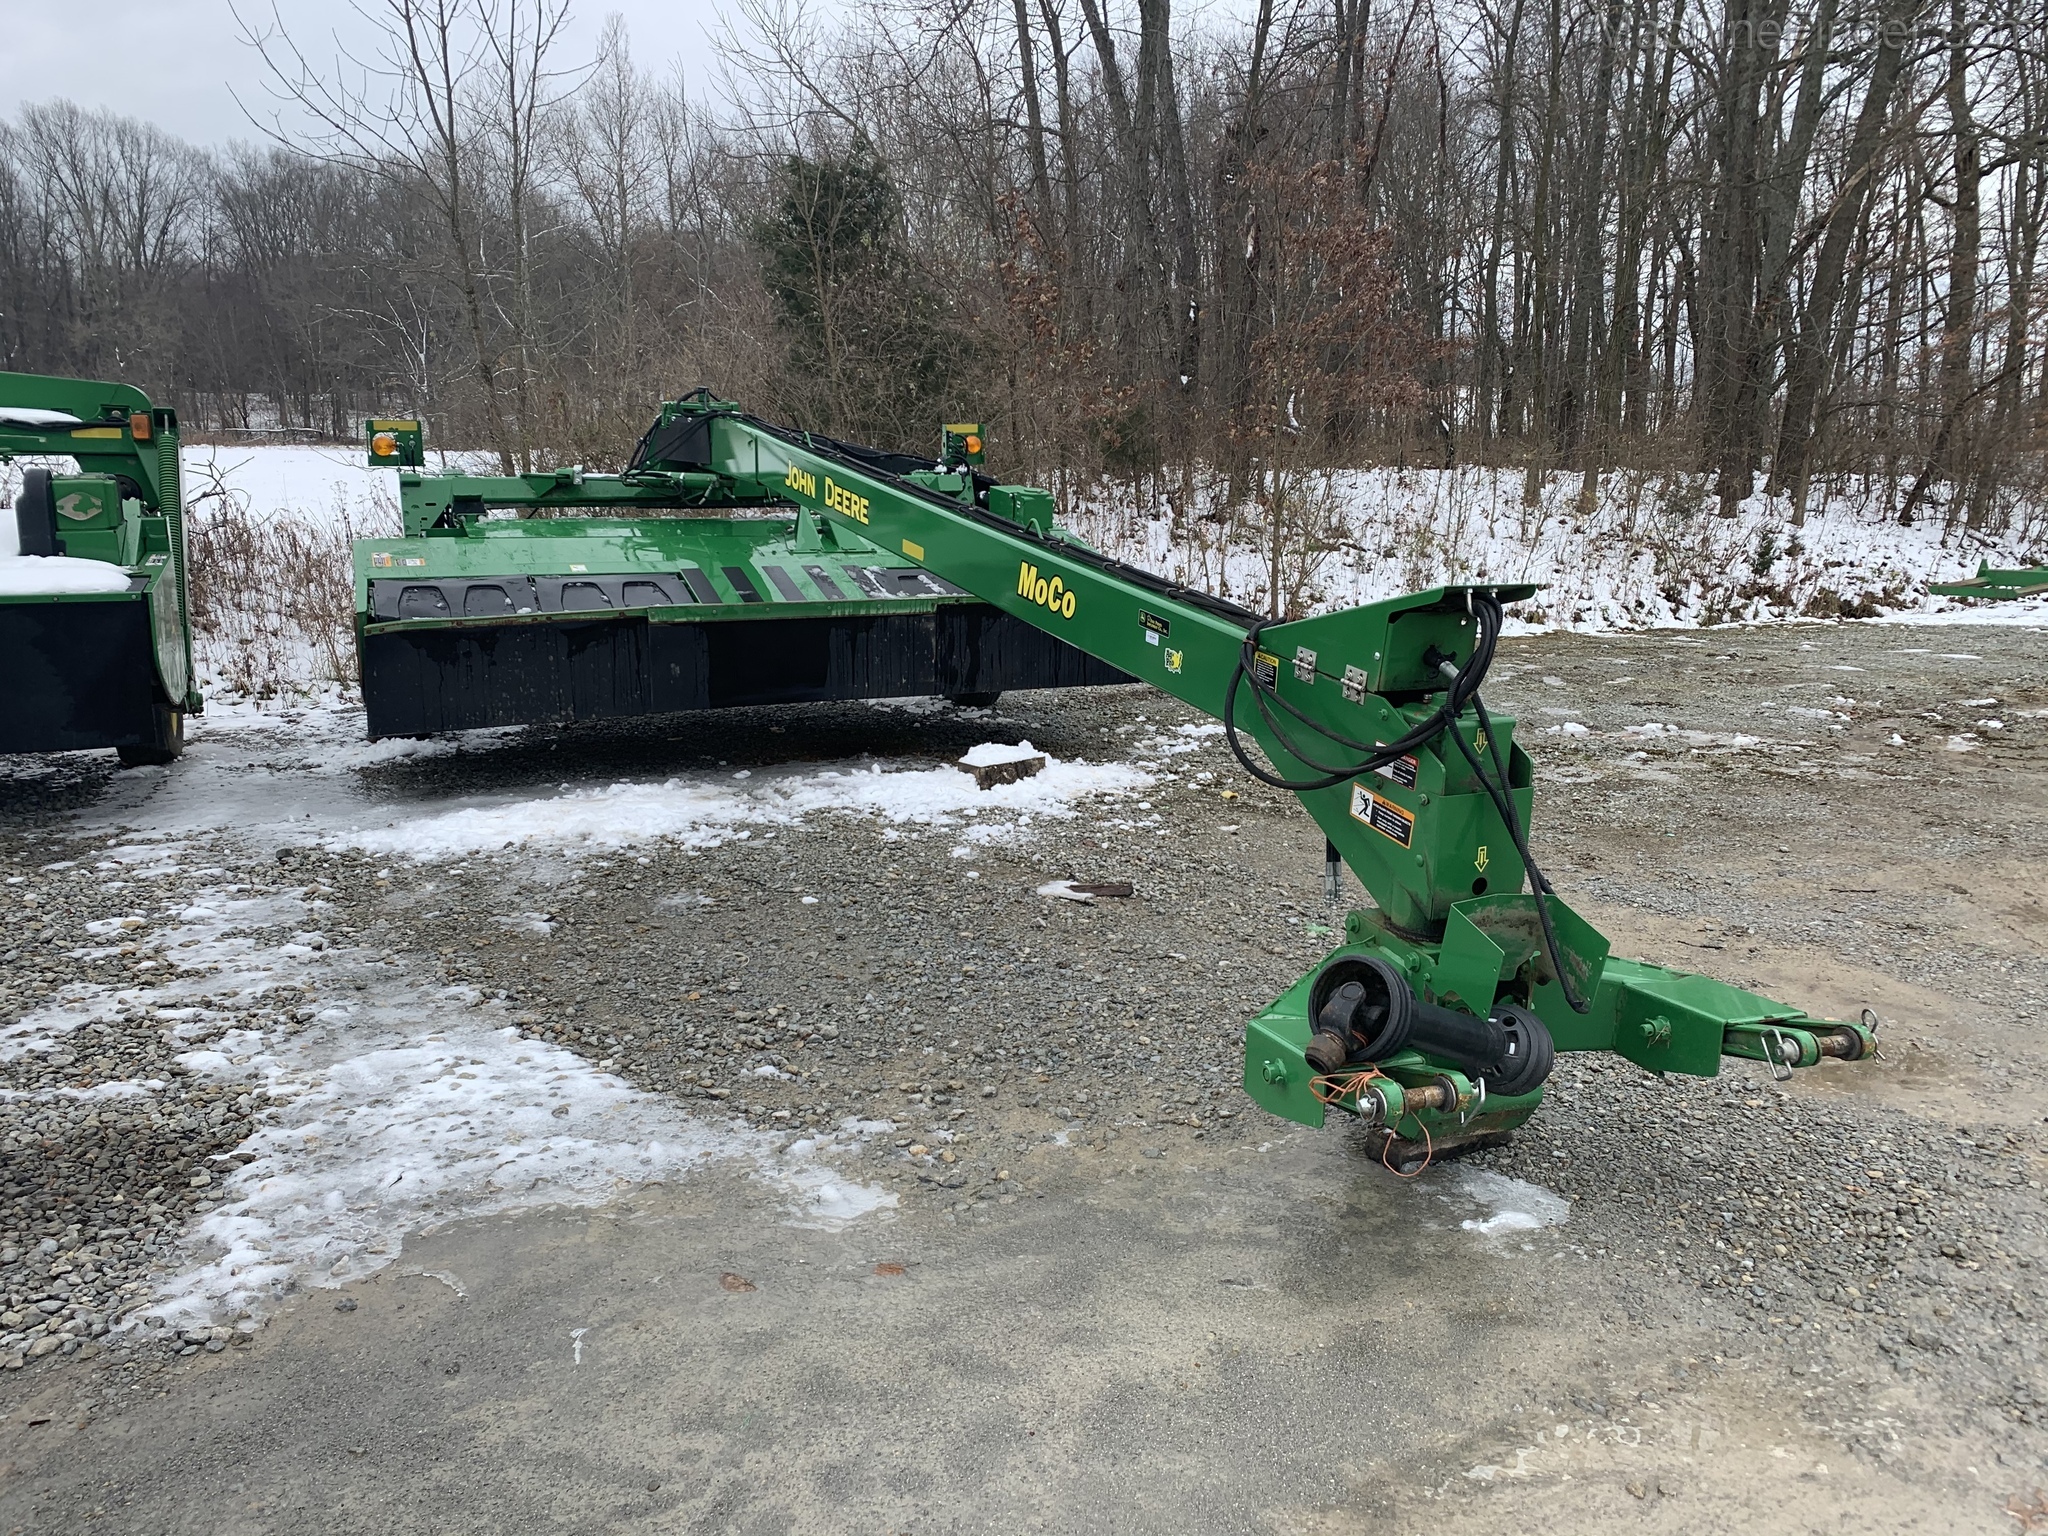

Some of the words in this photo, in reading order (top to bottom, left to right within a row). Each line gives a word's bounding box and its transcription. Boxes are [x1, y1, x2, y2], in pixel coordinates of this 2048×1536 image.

[785, 459, 816, 499] JOHN
[825, 476, 869, 526] DEERE
[1017, 561, 1076, 619] MoCo
